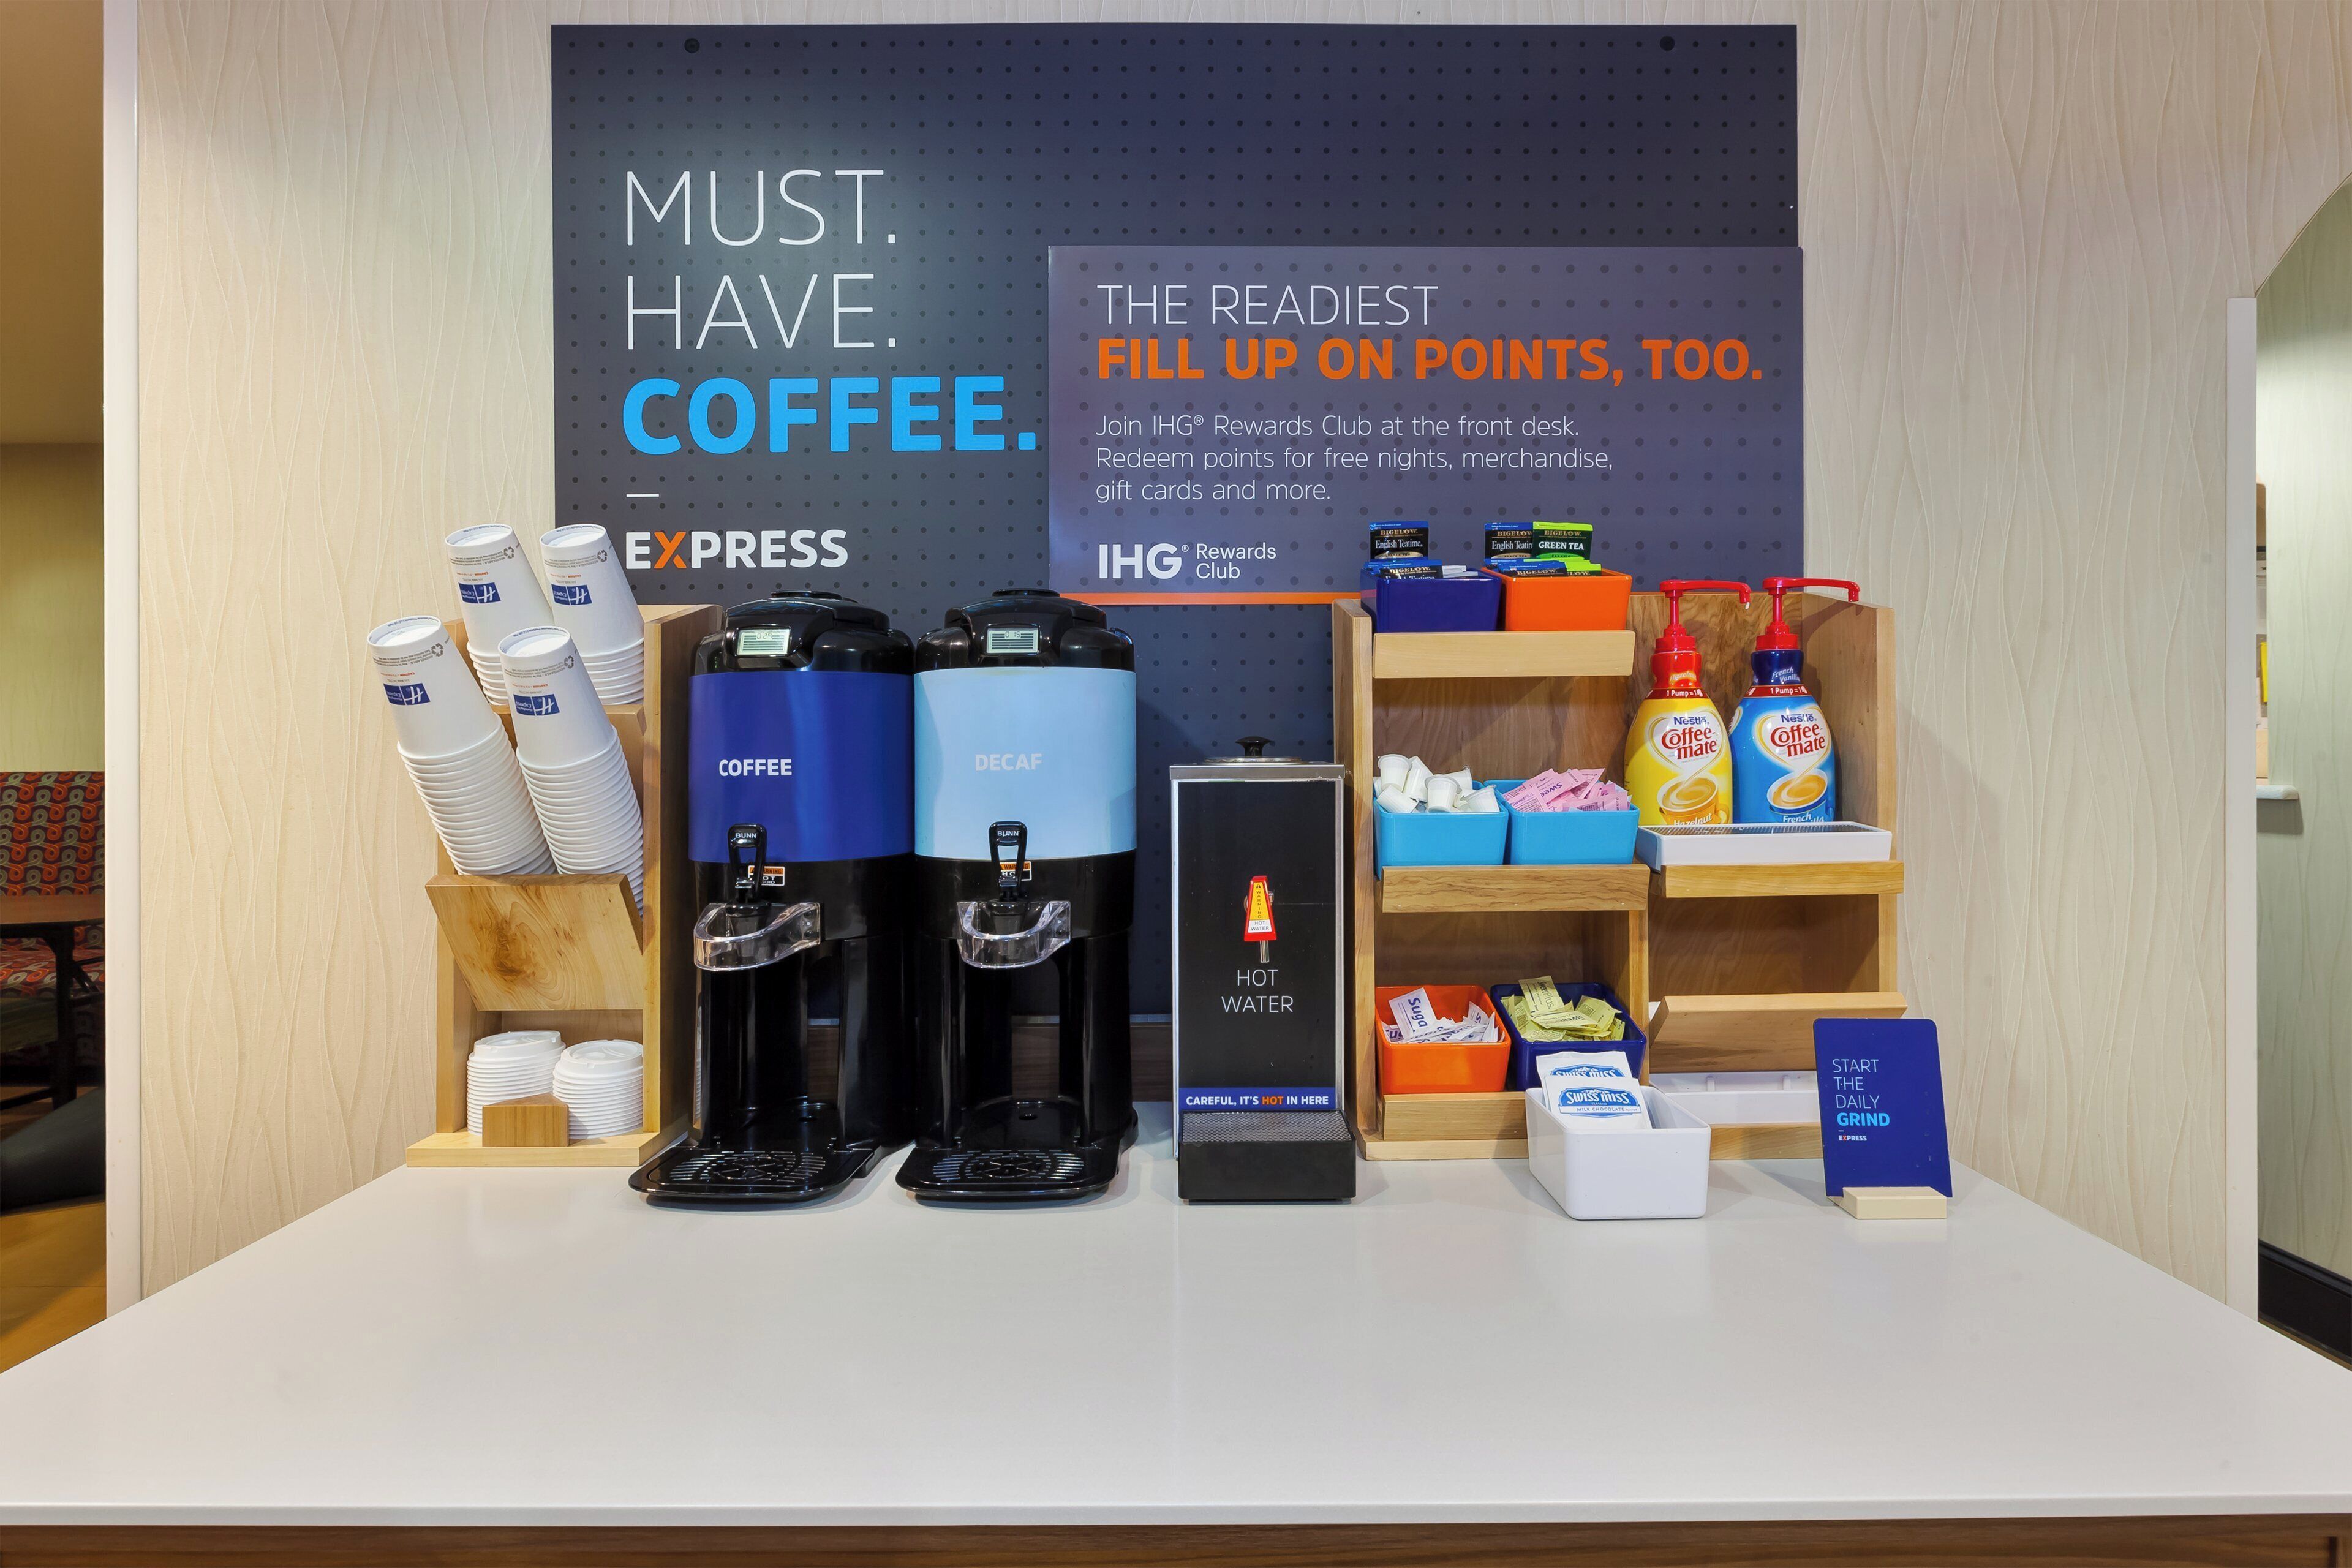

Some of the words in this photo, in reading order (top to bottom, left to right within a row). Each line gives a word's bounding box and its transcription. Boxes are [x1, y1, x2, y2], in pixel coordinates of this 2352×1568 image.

[627, 169, 896, 246] MUST.
[627, 273, 896, 350] HAVE.
[1097, 285, 1188, 325] THE
[1212, 285, 1439, 326] READIEST
[1098, 338, 1205, 379] FILL
[1226, 338, 1297, 379] UP
[1317, 338, 1393, 380] ON
[1415, 338, 1624, 386] POINTS,
[1642, 338, 1762, 380] TOO.
[623, 376, 1036, 455] COFFEE.
[1096, 415, 1143, 436] Join
[1153, 415, 1204, 436] IHG®
[1215, 415, 1313, 436] Rewards
[1322, 415, 1372, 436] Club
[1381, 417, 1403, 436] at
[1412, 415, 1449, 436] the
[1458, 415, 1513, 436] front
[1522, 415, 1579, 436] desk.
[1096, 448, 1193, 468] Redeem
[1204, 448, 1275, 470] points
[1284, 448, 1315, 468] for
[1324, 448, 1368, 468] free
[1378, 448, 1453, 471] nights,
[1463, 448, 1613, 471] merchandise,
[1096, 480, 1133, 503] gift
[1142, 480, 1203, 500] cards
[1212, 480, 1256, 500] and
[1266, 483, 1330, 500] more.
[625, 530, 848, 569] EXPRESS
[1196, 542, 1276, 560] Rewards
[1375, 540, 1397, 550] English
[1491, 541, 1513, 551] English
[1514, 540, 1533, 549] Teatim
[1539, 541, 1567, 550] GREEN
[1196, 562, 1241, 579] Club
[1771, 667, 1793, 679] French
[1677, 740, 1717, 760] mate
[1787, 736, 1826, 757] mate
[719, 759, 792, 776] COFFEE
[975, 753, 1042, 771] DECAF
[1783, 812, 1812, 824] French
[1237, 969, 1278, 987] HOT
[1221, 995, 1294, 1013] WATER
[1408, 997, 1428, 1028] Suga
[1832, 1058, 1879, 1073] START
[1833, 1077, 1864, 1091] THE
[1186, 1096, 1237, 1106] CAREFUL,
[1240, 1096, 1259, 1106] IT'S
[1262, 1096, 1284, 1106] HOT
[1287, 1096, 1298, 1105] IN
[1301, 1096, 1329, 1106] HERE
[1566, 1091, 1599, 1104] SWISS
[1600, 1092, 1630, 1104] MISS
[1835, 1095, 1880, 1109] DAILY
[1837, 1112, 1890, 1126] GRIND
